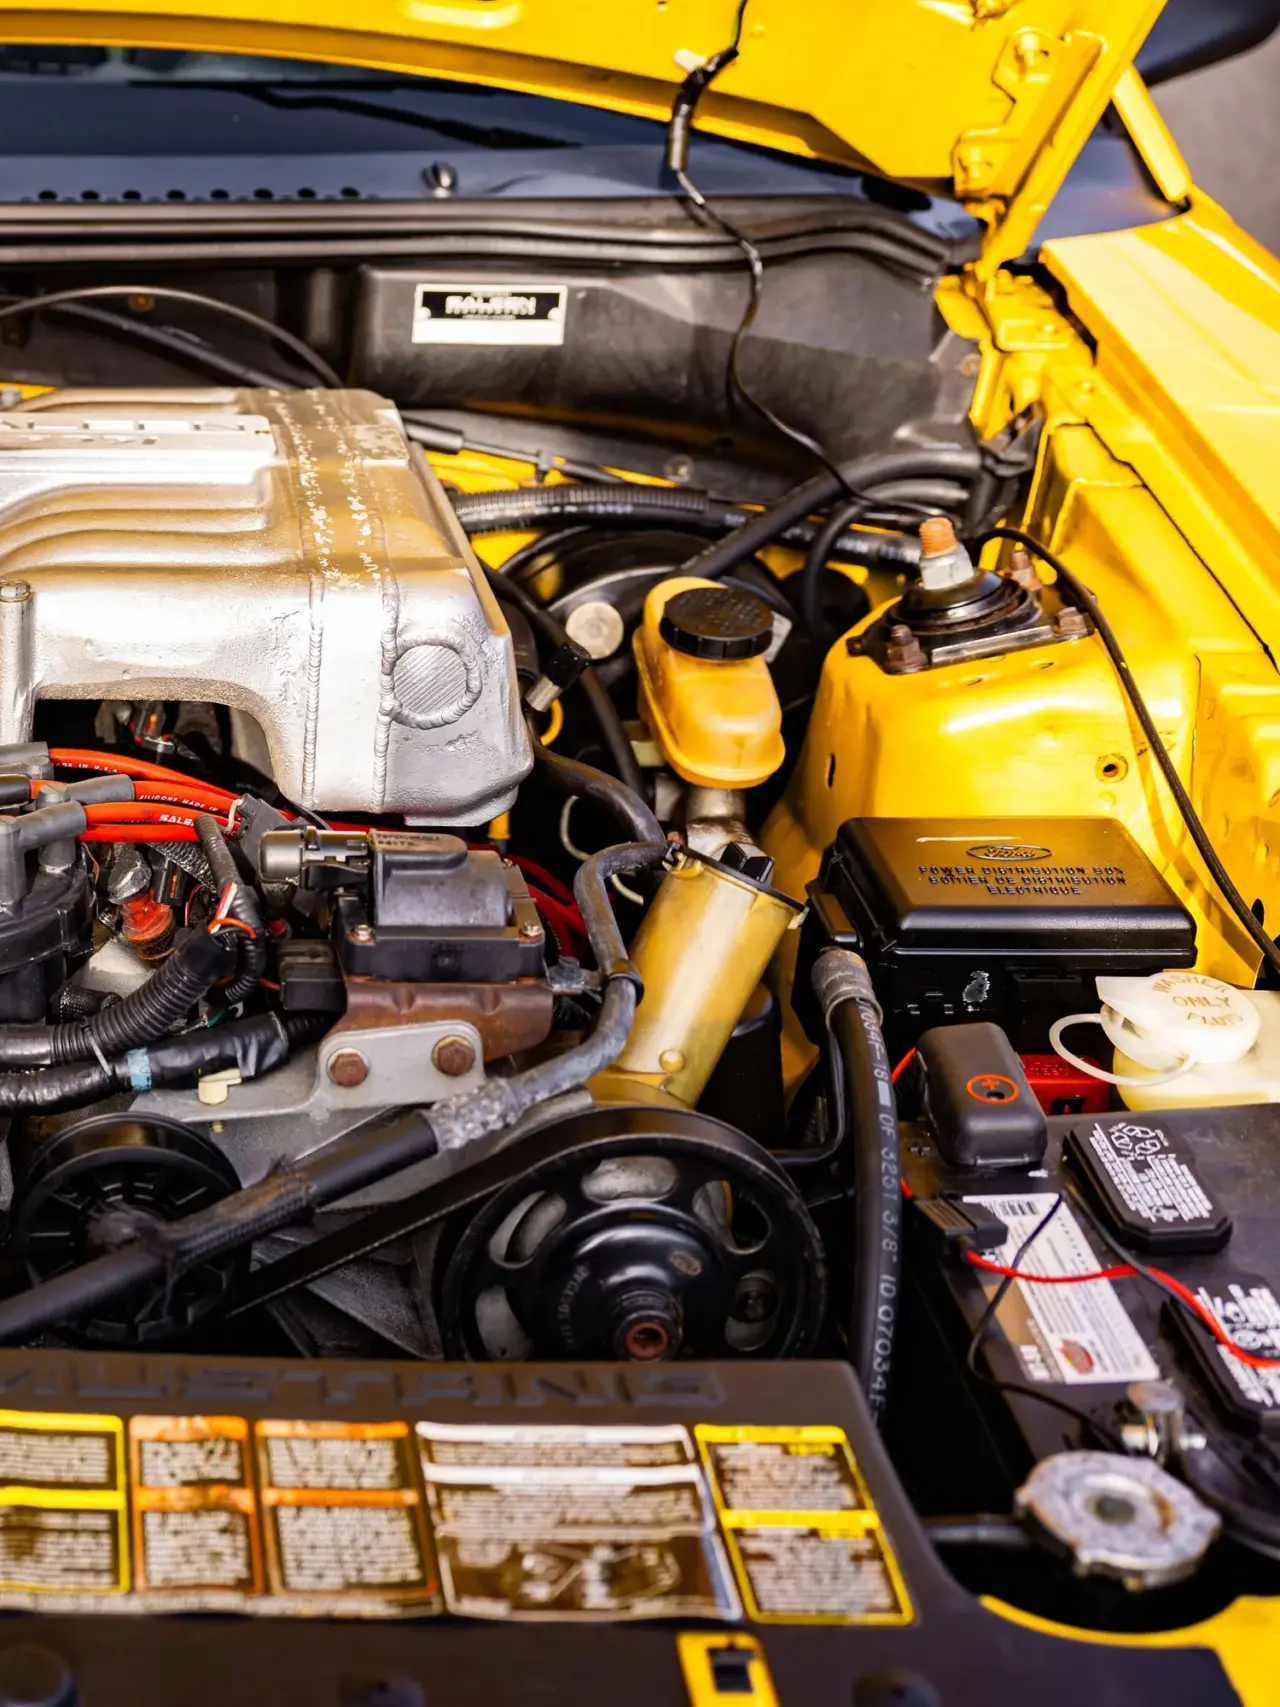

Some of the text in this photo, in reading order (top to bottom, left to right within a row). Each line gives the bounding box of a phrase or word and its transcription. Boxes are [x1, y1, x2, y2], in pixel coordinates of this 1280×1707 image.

[182, 798, 206, 808] MADE
[158, 813, 195, 827] SALE
[983, 844, 1037, 858] Ford
[918, 865, 1125, 876] POWER DISTRIBUTION BOX
[994, 876, 1017, 885] DE
[1024, 876, 1127, 885] DISTRIBUTION
[1172, 996, 1231, 1008] ONLY
